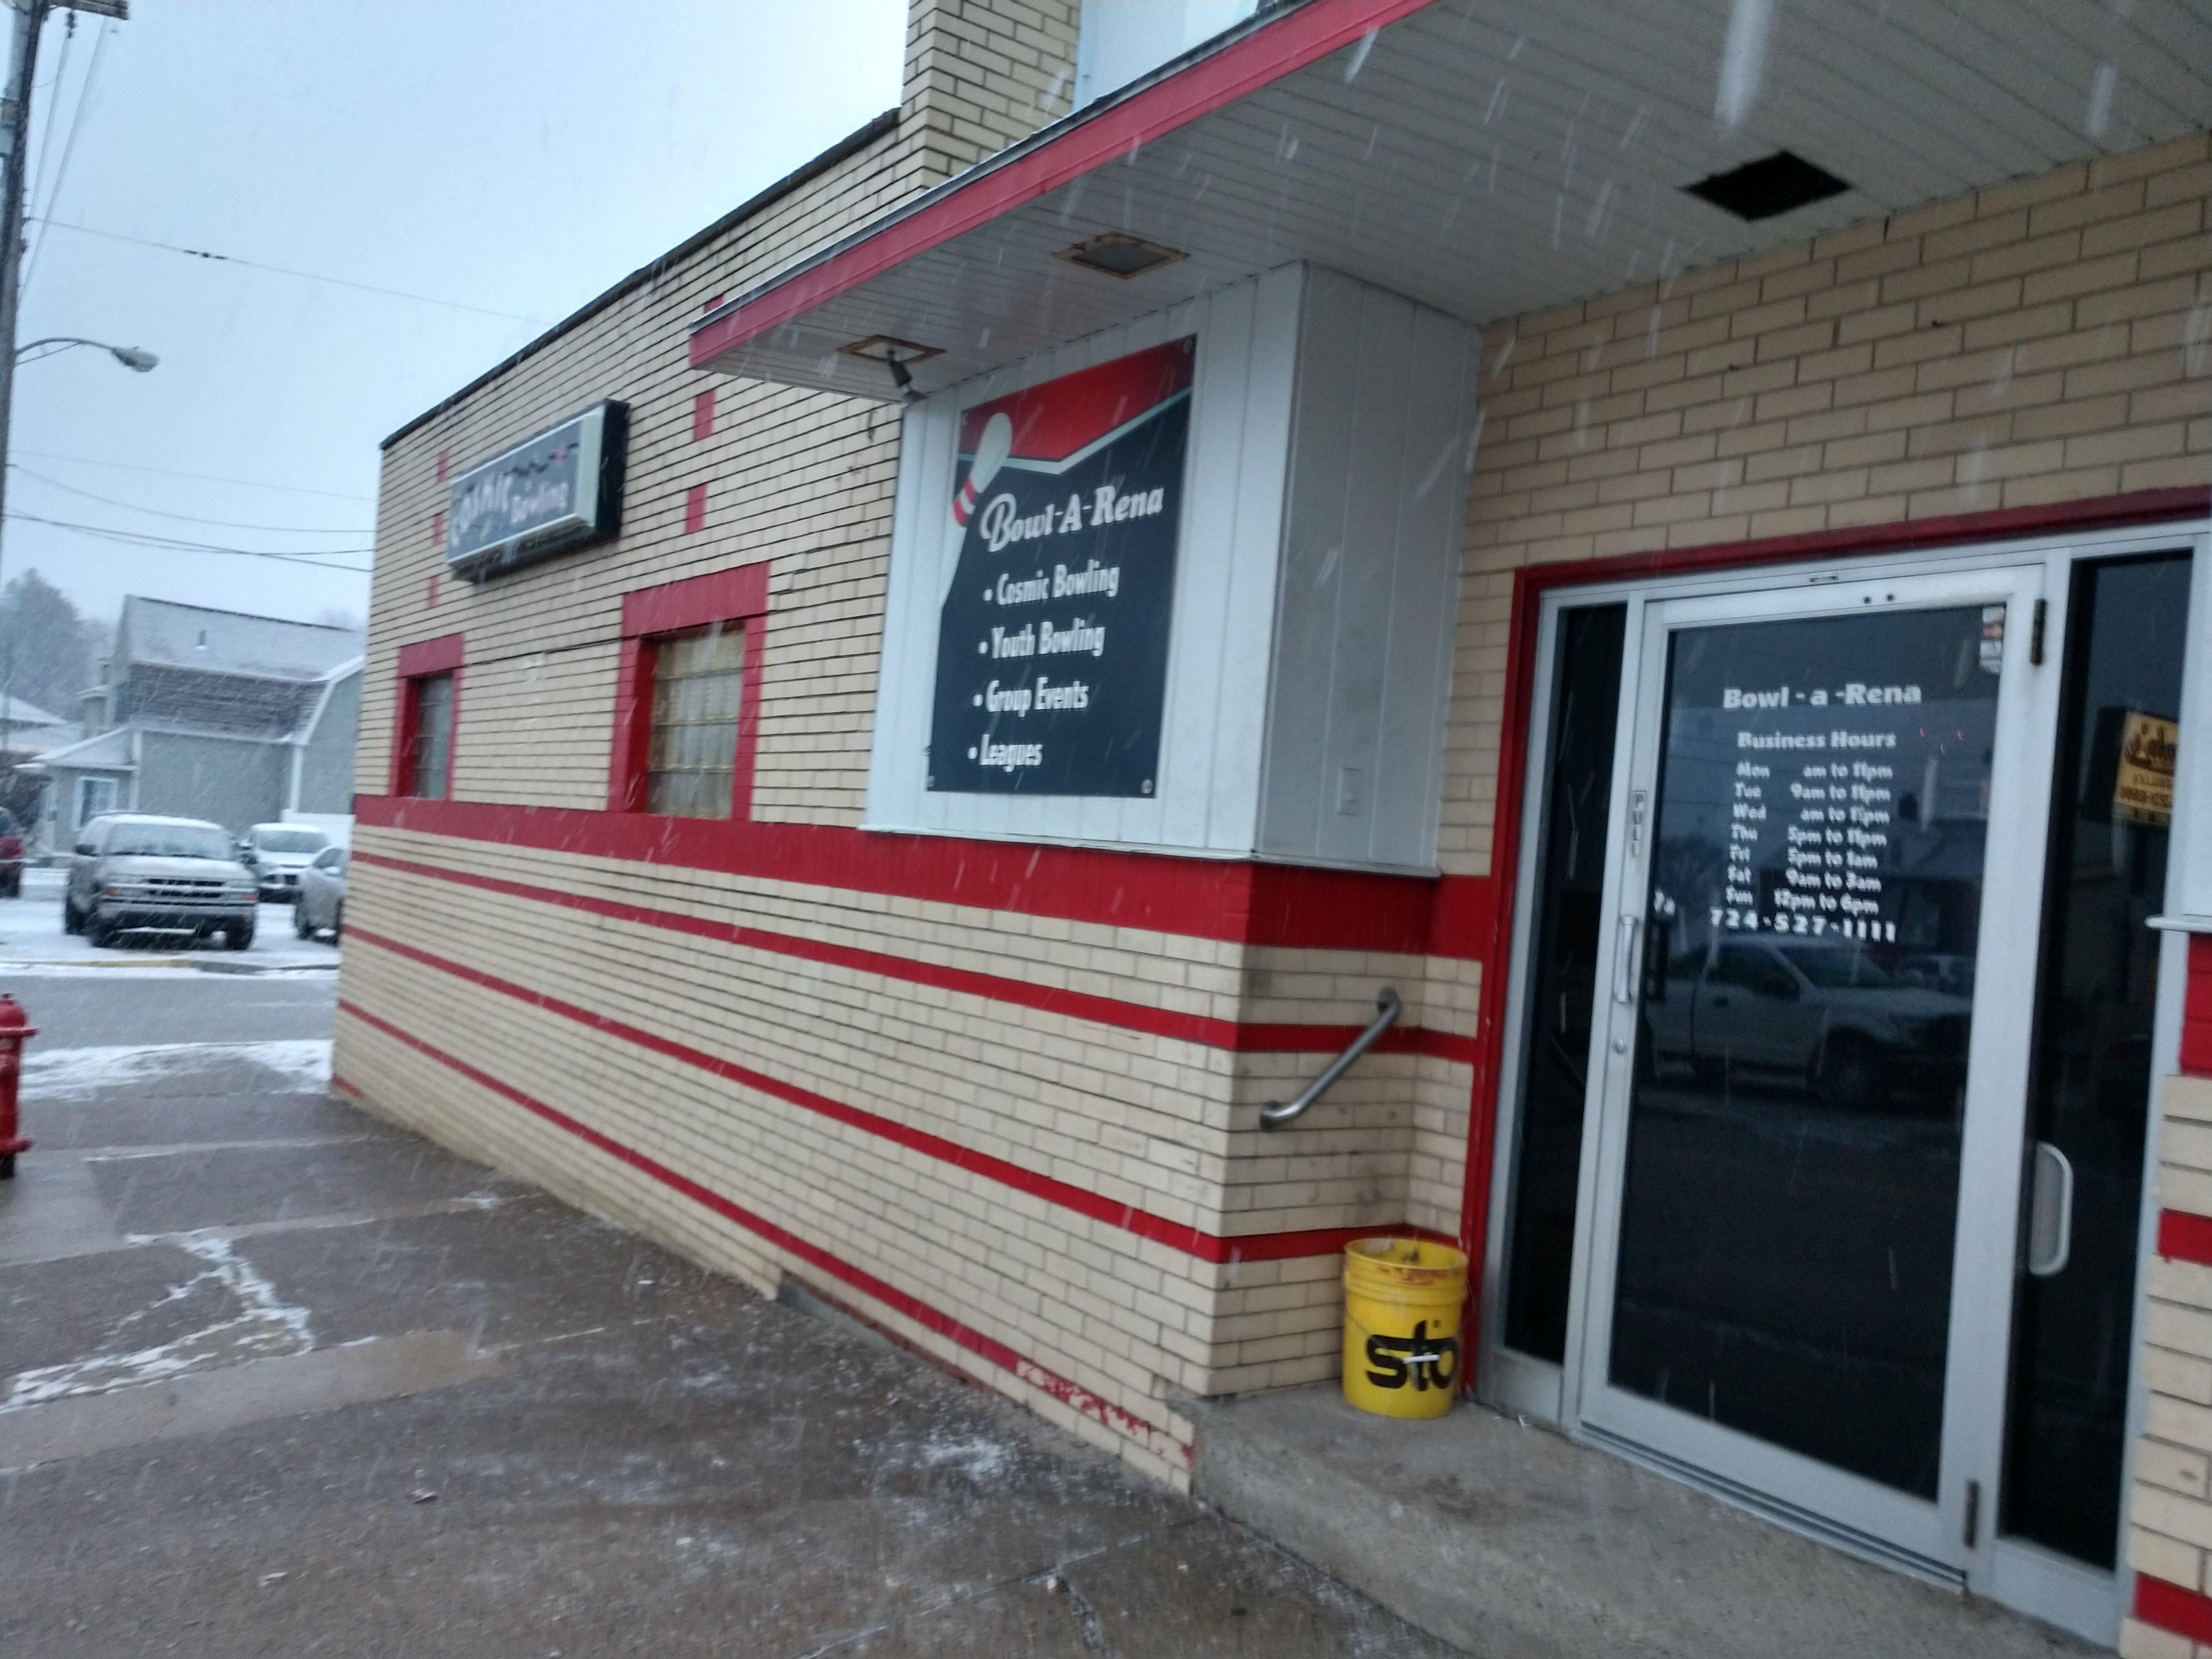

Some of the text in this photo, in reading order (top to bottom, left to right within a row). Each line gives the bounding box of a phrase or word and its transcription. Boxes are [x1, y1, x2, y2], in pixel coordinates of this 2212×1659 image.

[980, 485, 1164, 552] Bowl-A-Rena
[997, 559, 1119, 605] Cosmic Bowling
[992, 618, 1105, 658] Youth Bowling
[987, 677, 1088, 717] Group Events
[1738, 731, 1896, 748] Business Hours
[980, 734, 1042, 772] Leagues
[1736, 761, 1770, 777] Mon
[1831, 763, 1848, 778] to
[1735, 781, 1761, 797] Tue
[1829, 785, 1846, 799] to
[1733, 804, 1766, 819] Wed
[1828, 806, 1845, 821] to
[1825, 828, 1843, 843] to
[1730, 843, 1750, 861] Fri
[1825, 851, 1843, 866] to
[1728, 864, 1751, 884] Sat
[1824, 872, 1842, 888] to
[1726, 886, 1753, 904] Sun
[1819, 894, 1837, 910] to
